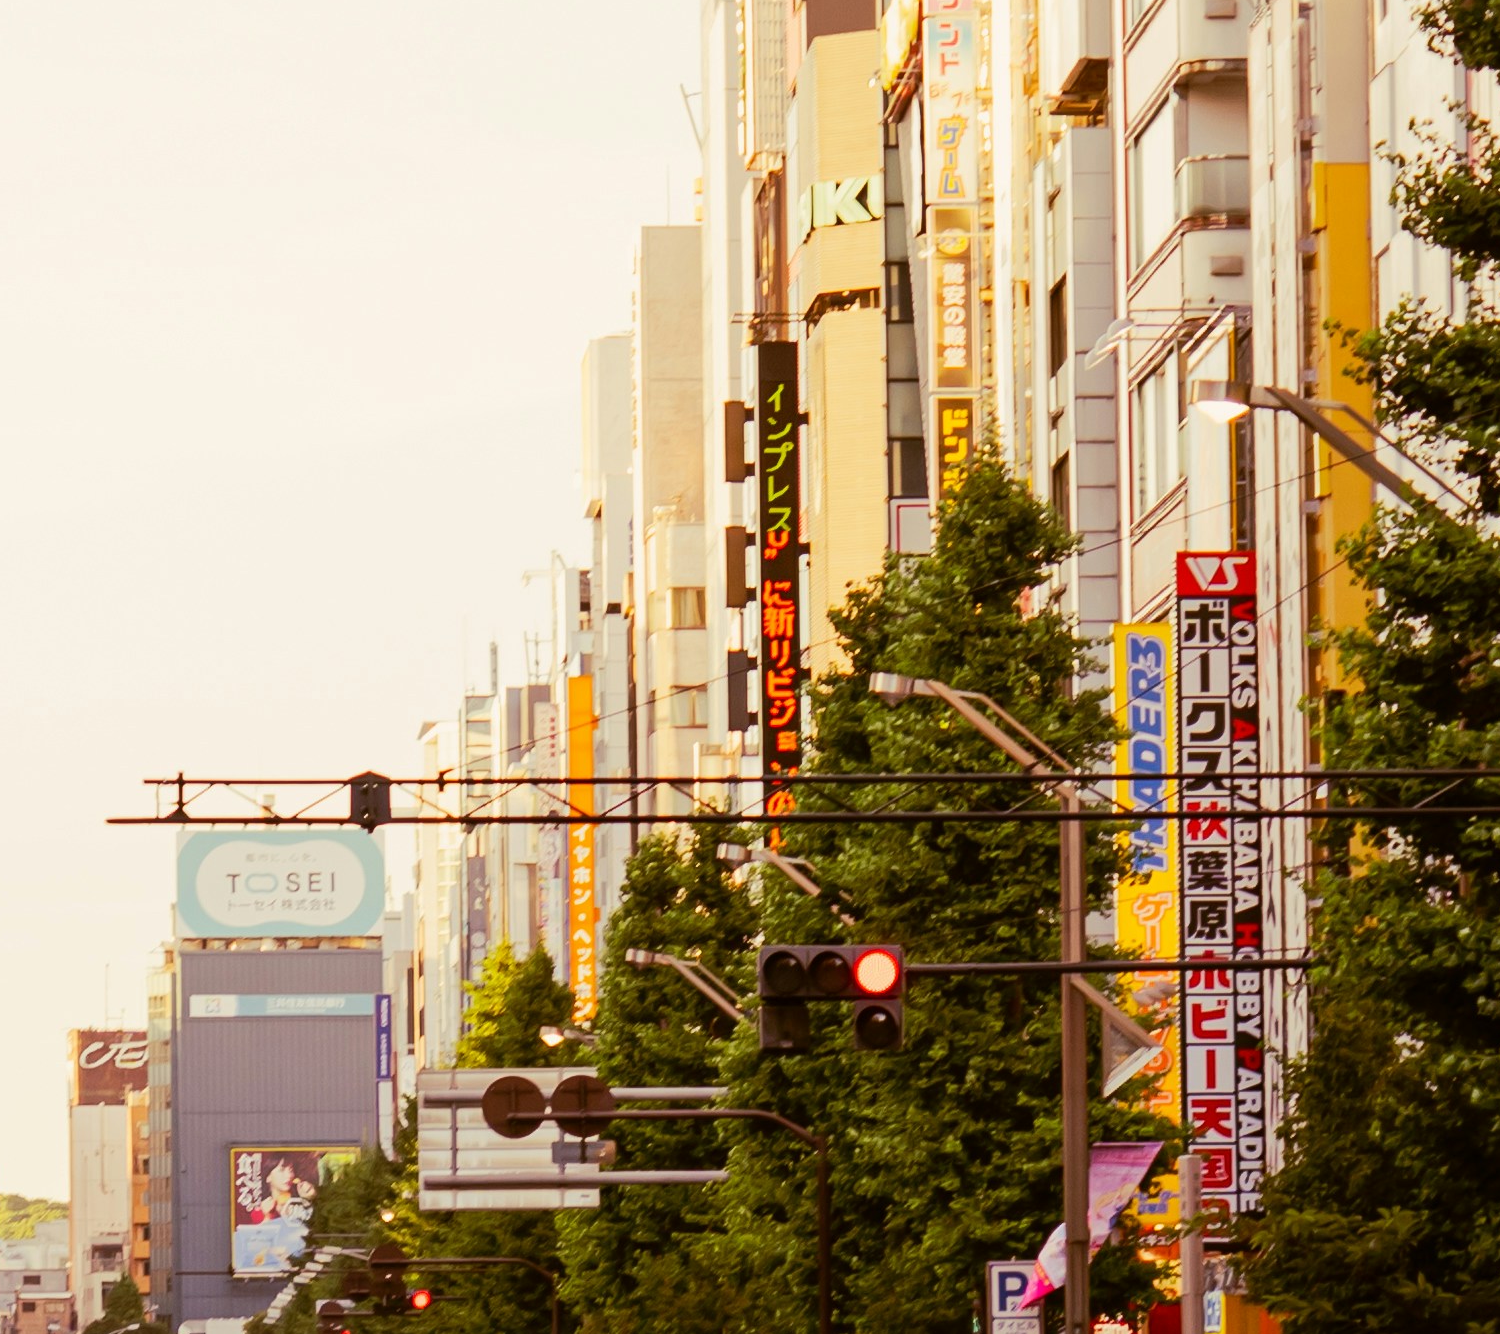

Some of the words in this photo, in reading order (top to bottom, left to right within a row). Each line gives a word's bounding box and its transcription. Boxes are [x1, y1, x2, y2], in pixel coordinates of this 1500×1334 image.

[766, 382, 795, 533] インプレス
[1230, 600, 1259, 711] VOLKS
[1236, 1047, 1265, 1214] PARADISE
[998, 1271, 1028, 1313] P
